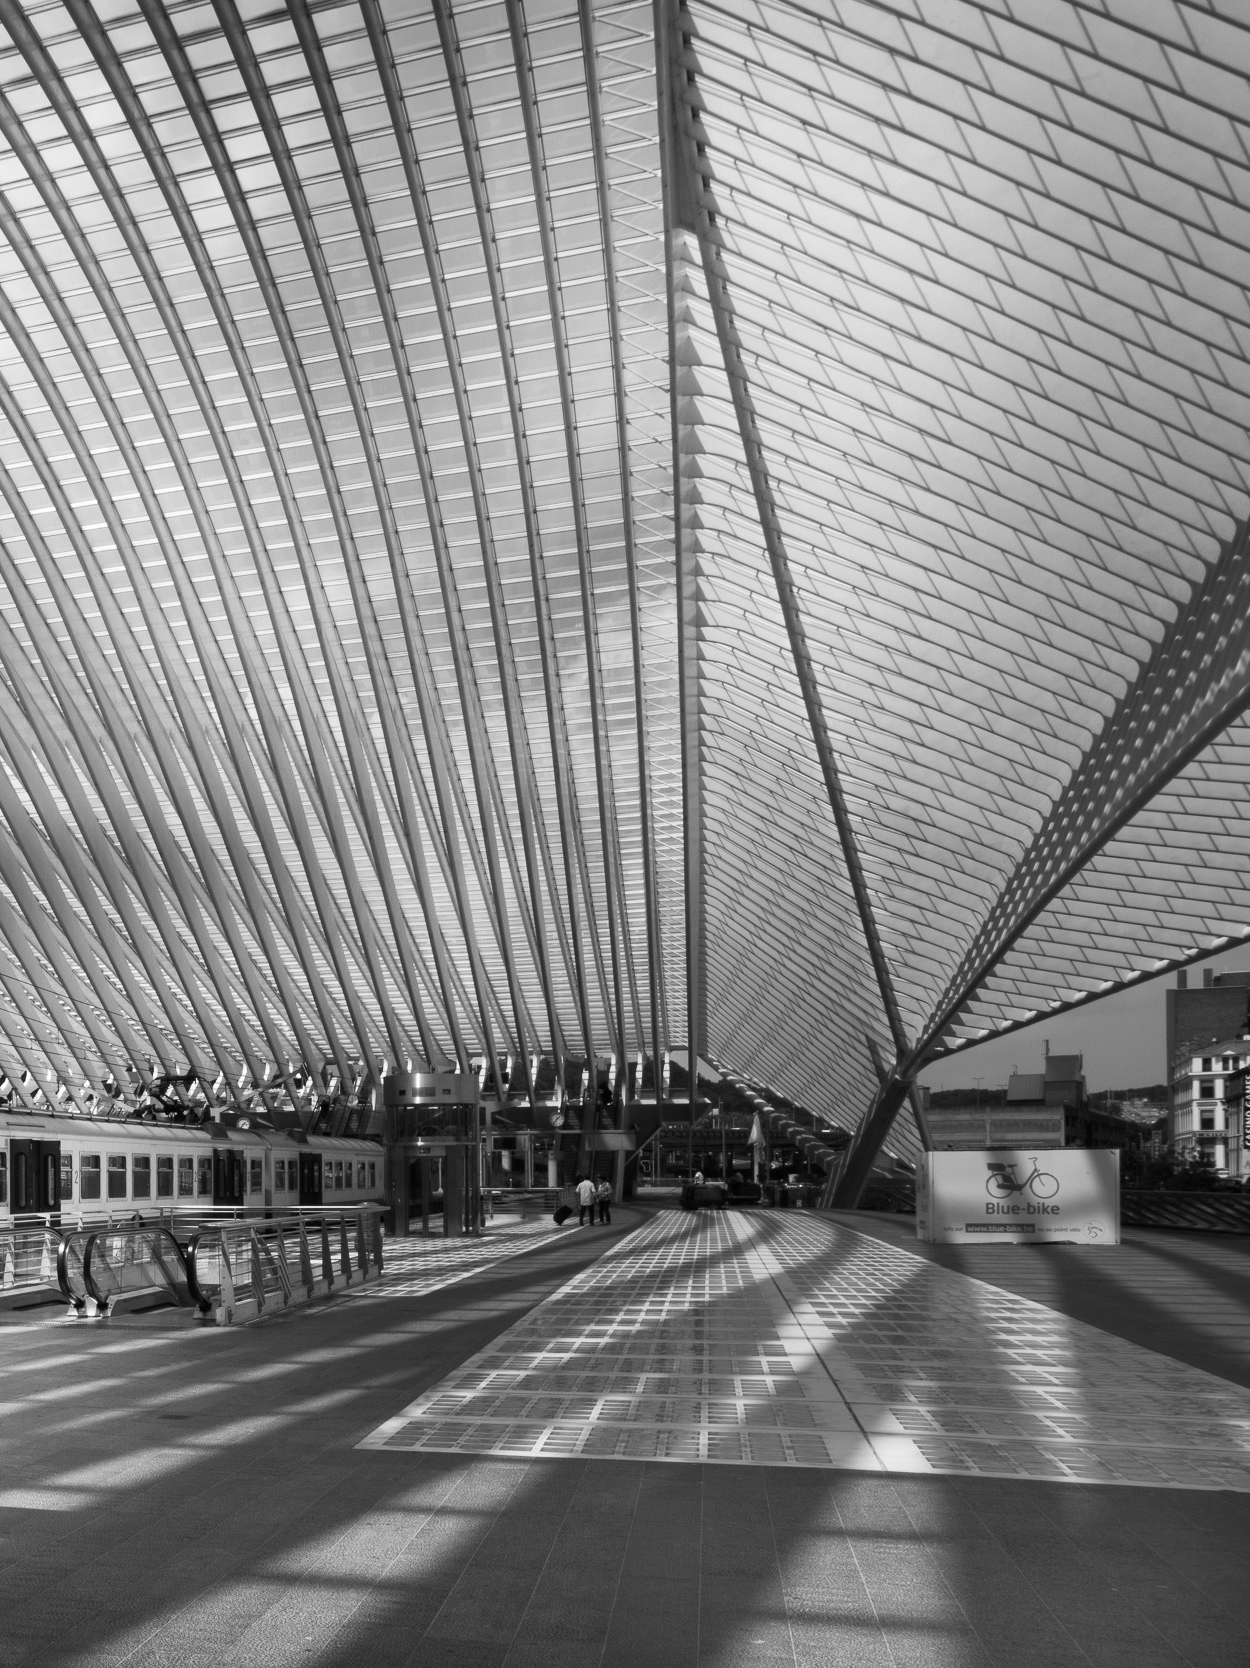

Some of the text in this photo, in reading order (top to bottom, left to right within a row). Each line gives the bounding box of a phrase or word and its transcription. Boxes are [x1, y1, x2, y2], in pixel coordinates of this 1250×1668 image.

[74, 1170, 79, 1184] 2
[985, 1202, 1060, 1215] Blue-bike
[967, 1224, 1034, 1232] www.blue-bike.be
